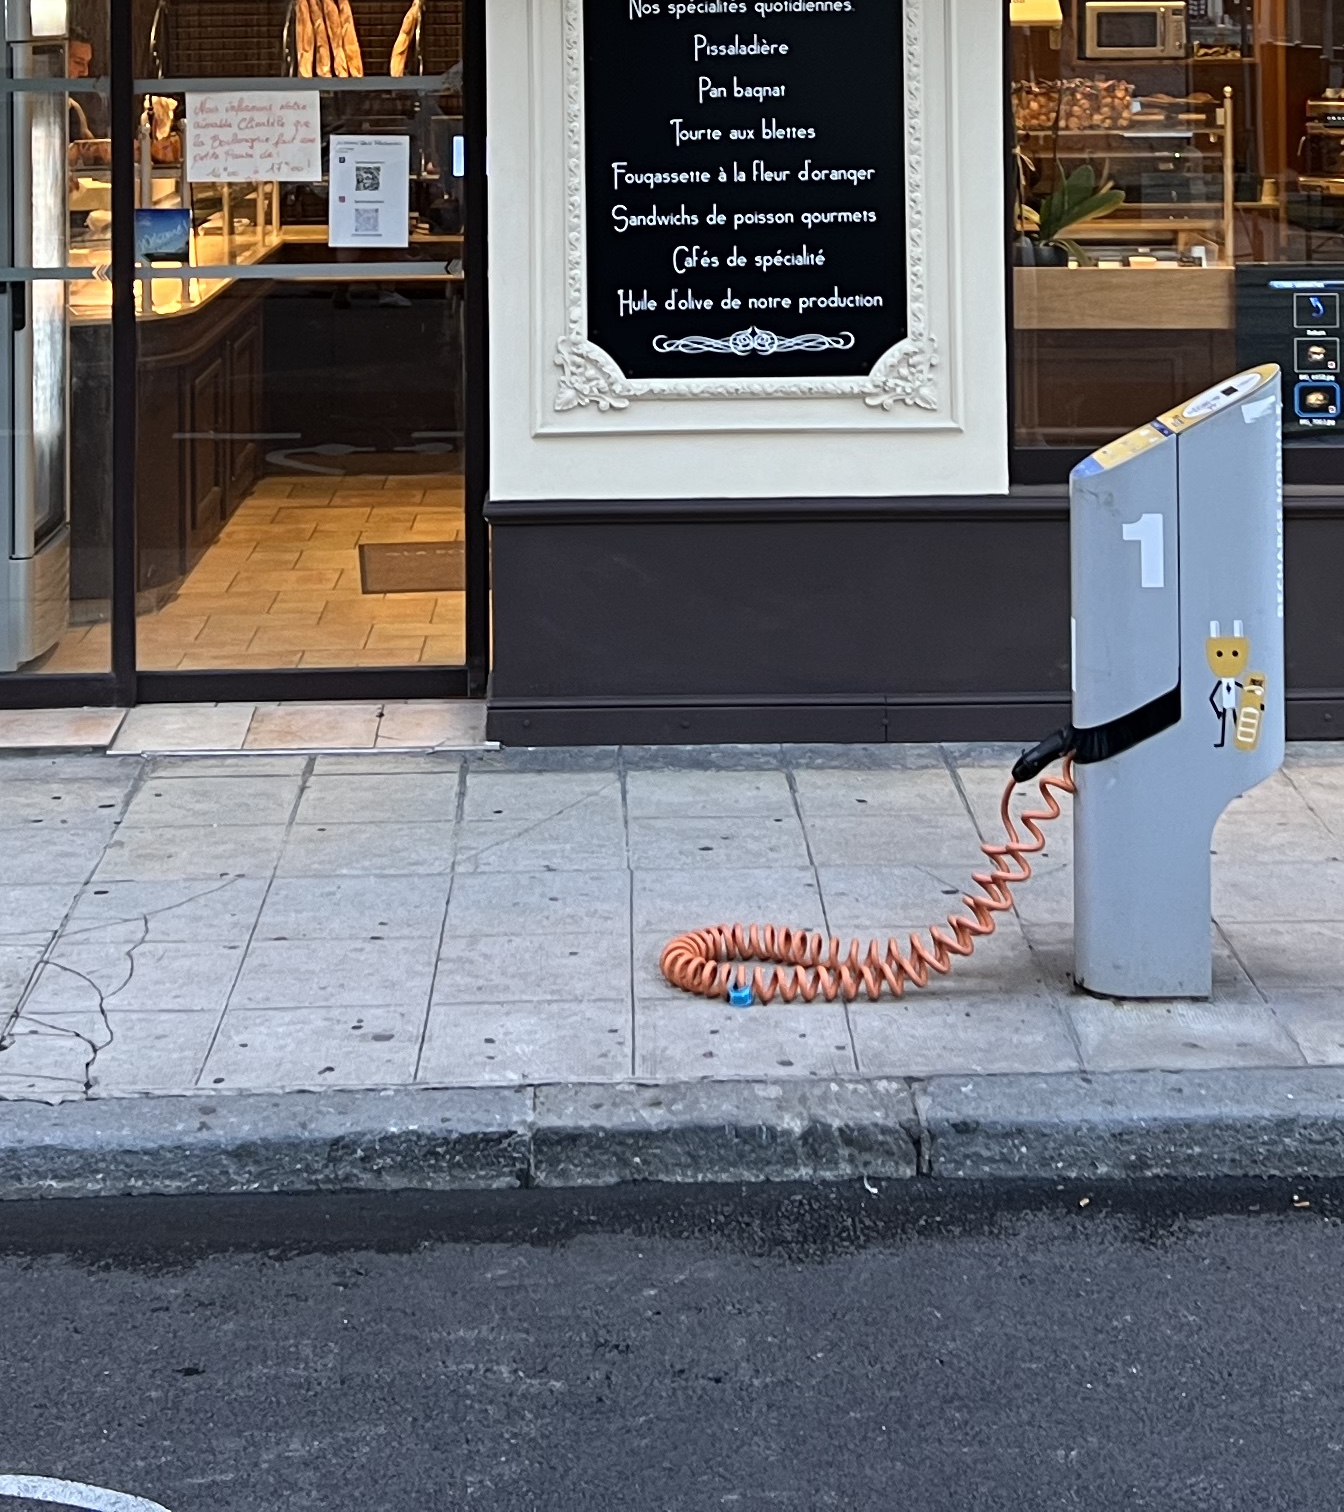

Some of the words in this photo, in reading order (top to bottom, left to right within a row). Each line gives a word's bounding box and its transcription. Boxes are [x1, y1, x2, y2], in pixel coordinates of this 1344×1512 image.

[693, 33, 790, 62] Pissaladière
[698, 75, 727, 104] Pan
[669, 118, 722, 147] Tourte
[729, 126, 756, 140] aux
[761, 117, 817, 140] blettes
[611, 161, 711, 190] Fougassette
[717, 166, 728, 183] à
[733, 160, 747, 183] la
[752, 159, 791, 182] fleur
[611, 203, 699, 233] Sandwichs
[706, 202, 727, 225] de
[733, 210, 795, 231] poisson
[800, 209, 877, 229] gourmets
[672, 245, 720, 275] Cafés
[726, 244, 748, 268] de
[754, 243, 826, 272] spécialité
[617, 288, 658, 317] Huile
[720, 287, 742, 310] de
[748, 296, 792, 309] notre
[798, 285, 884, 314] production
[1122, 513, 1165, 588] 1
